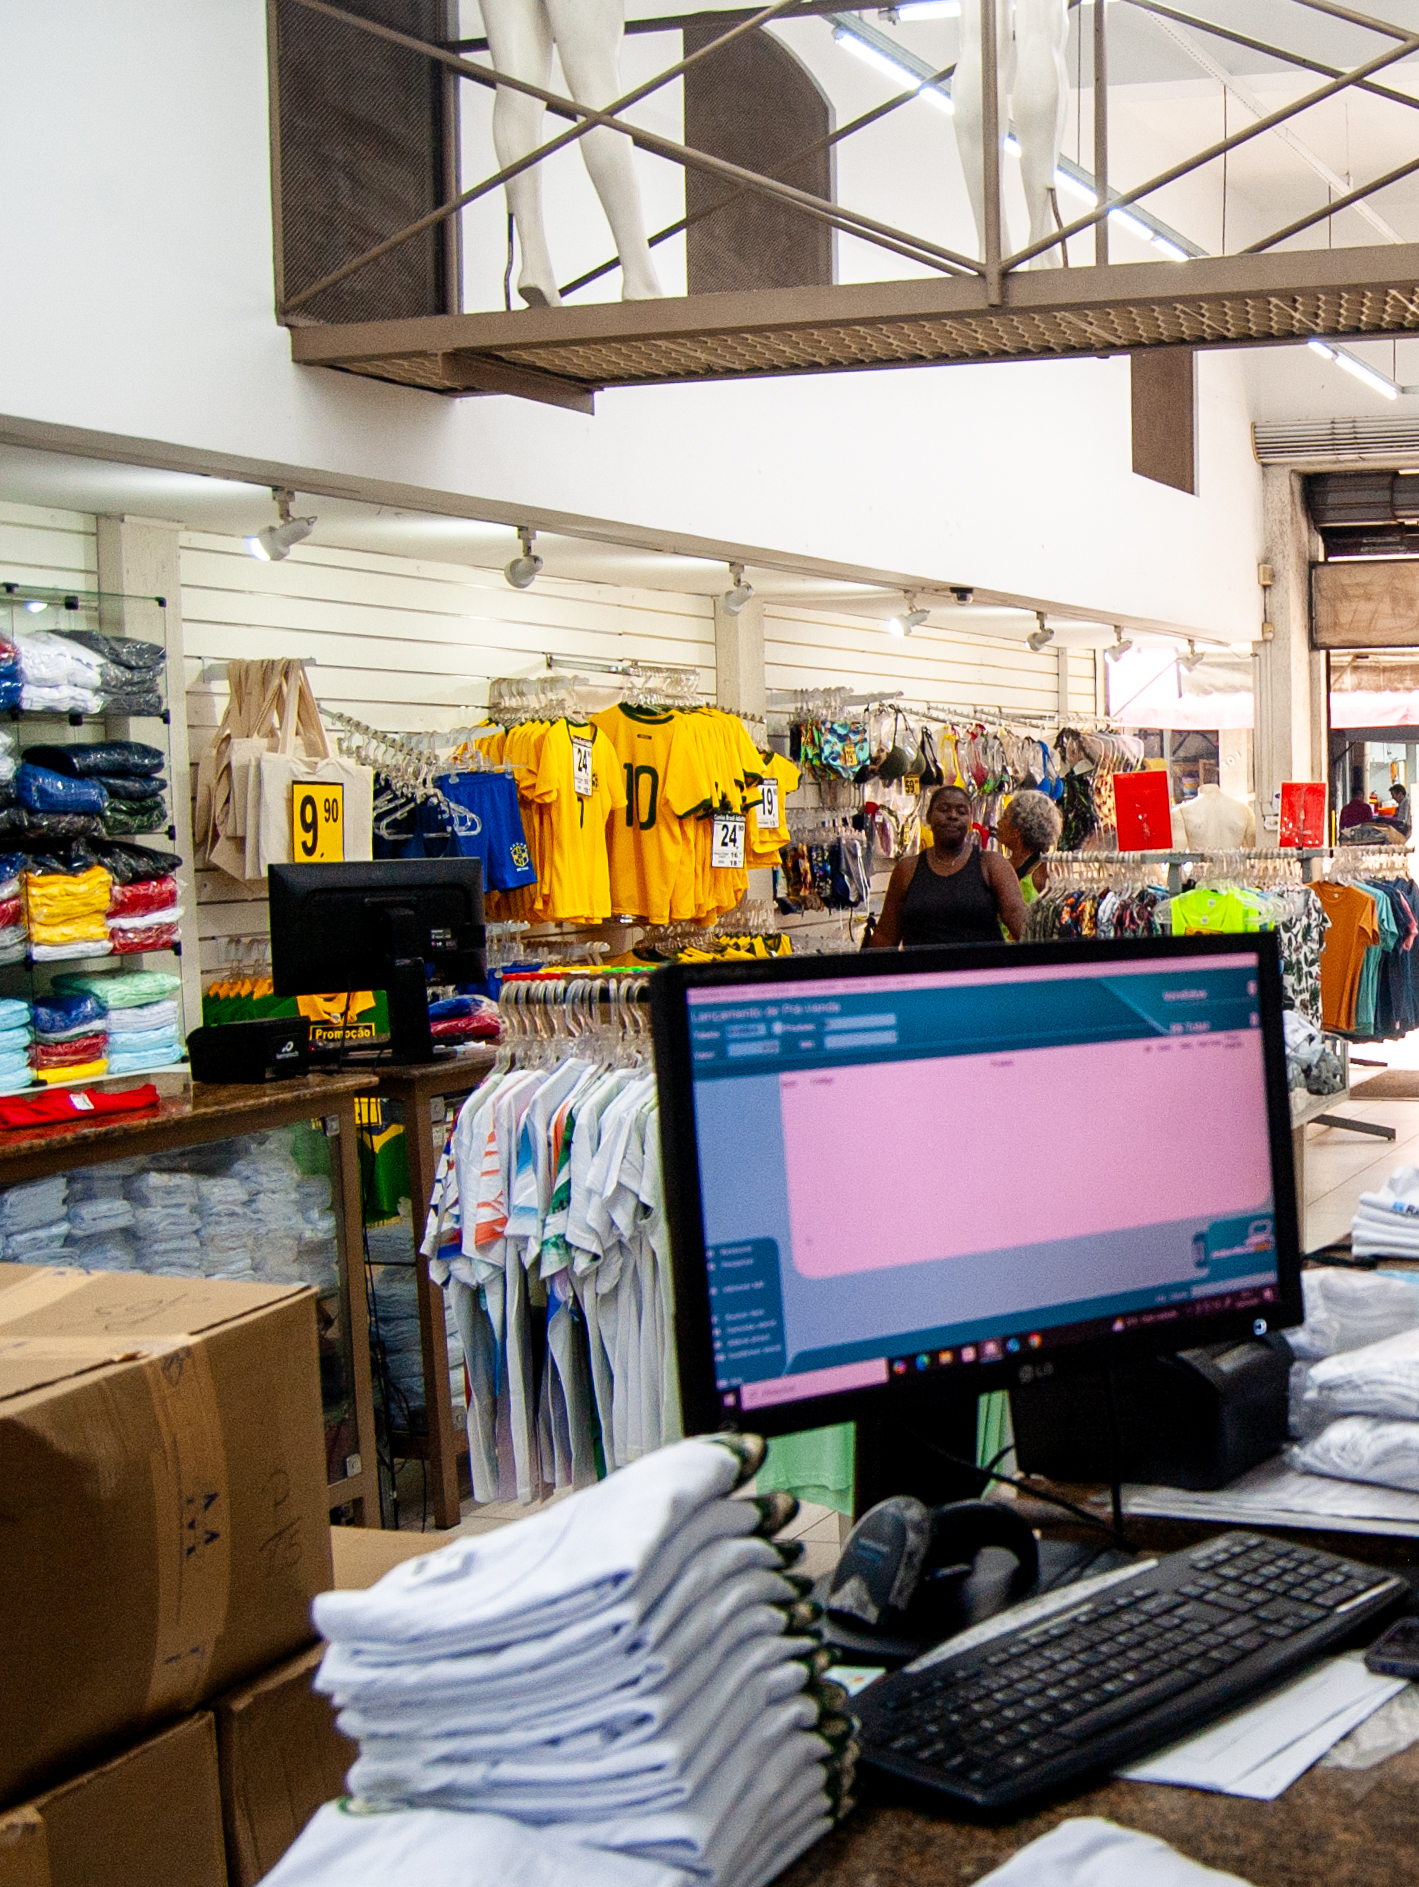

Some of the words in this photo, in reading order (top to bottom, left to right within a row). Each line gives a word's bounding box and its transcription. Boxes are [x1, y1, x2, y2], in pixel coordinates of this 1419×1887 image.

[623, 762, 659, 830] 10
[324, 798, 339, 823] 90
[315, 1028, 371, 1041] Promoção
